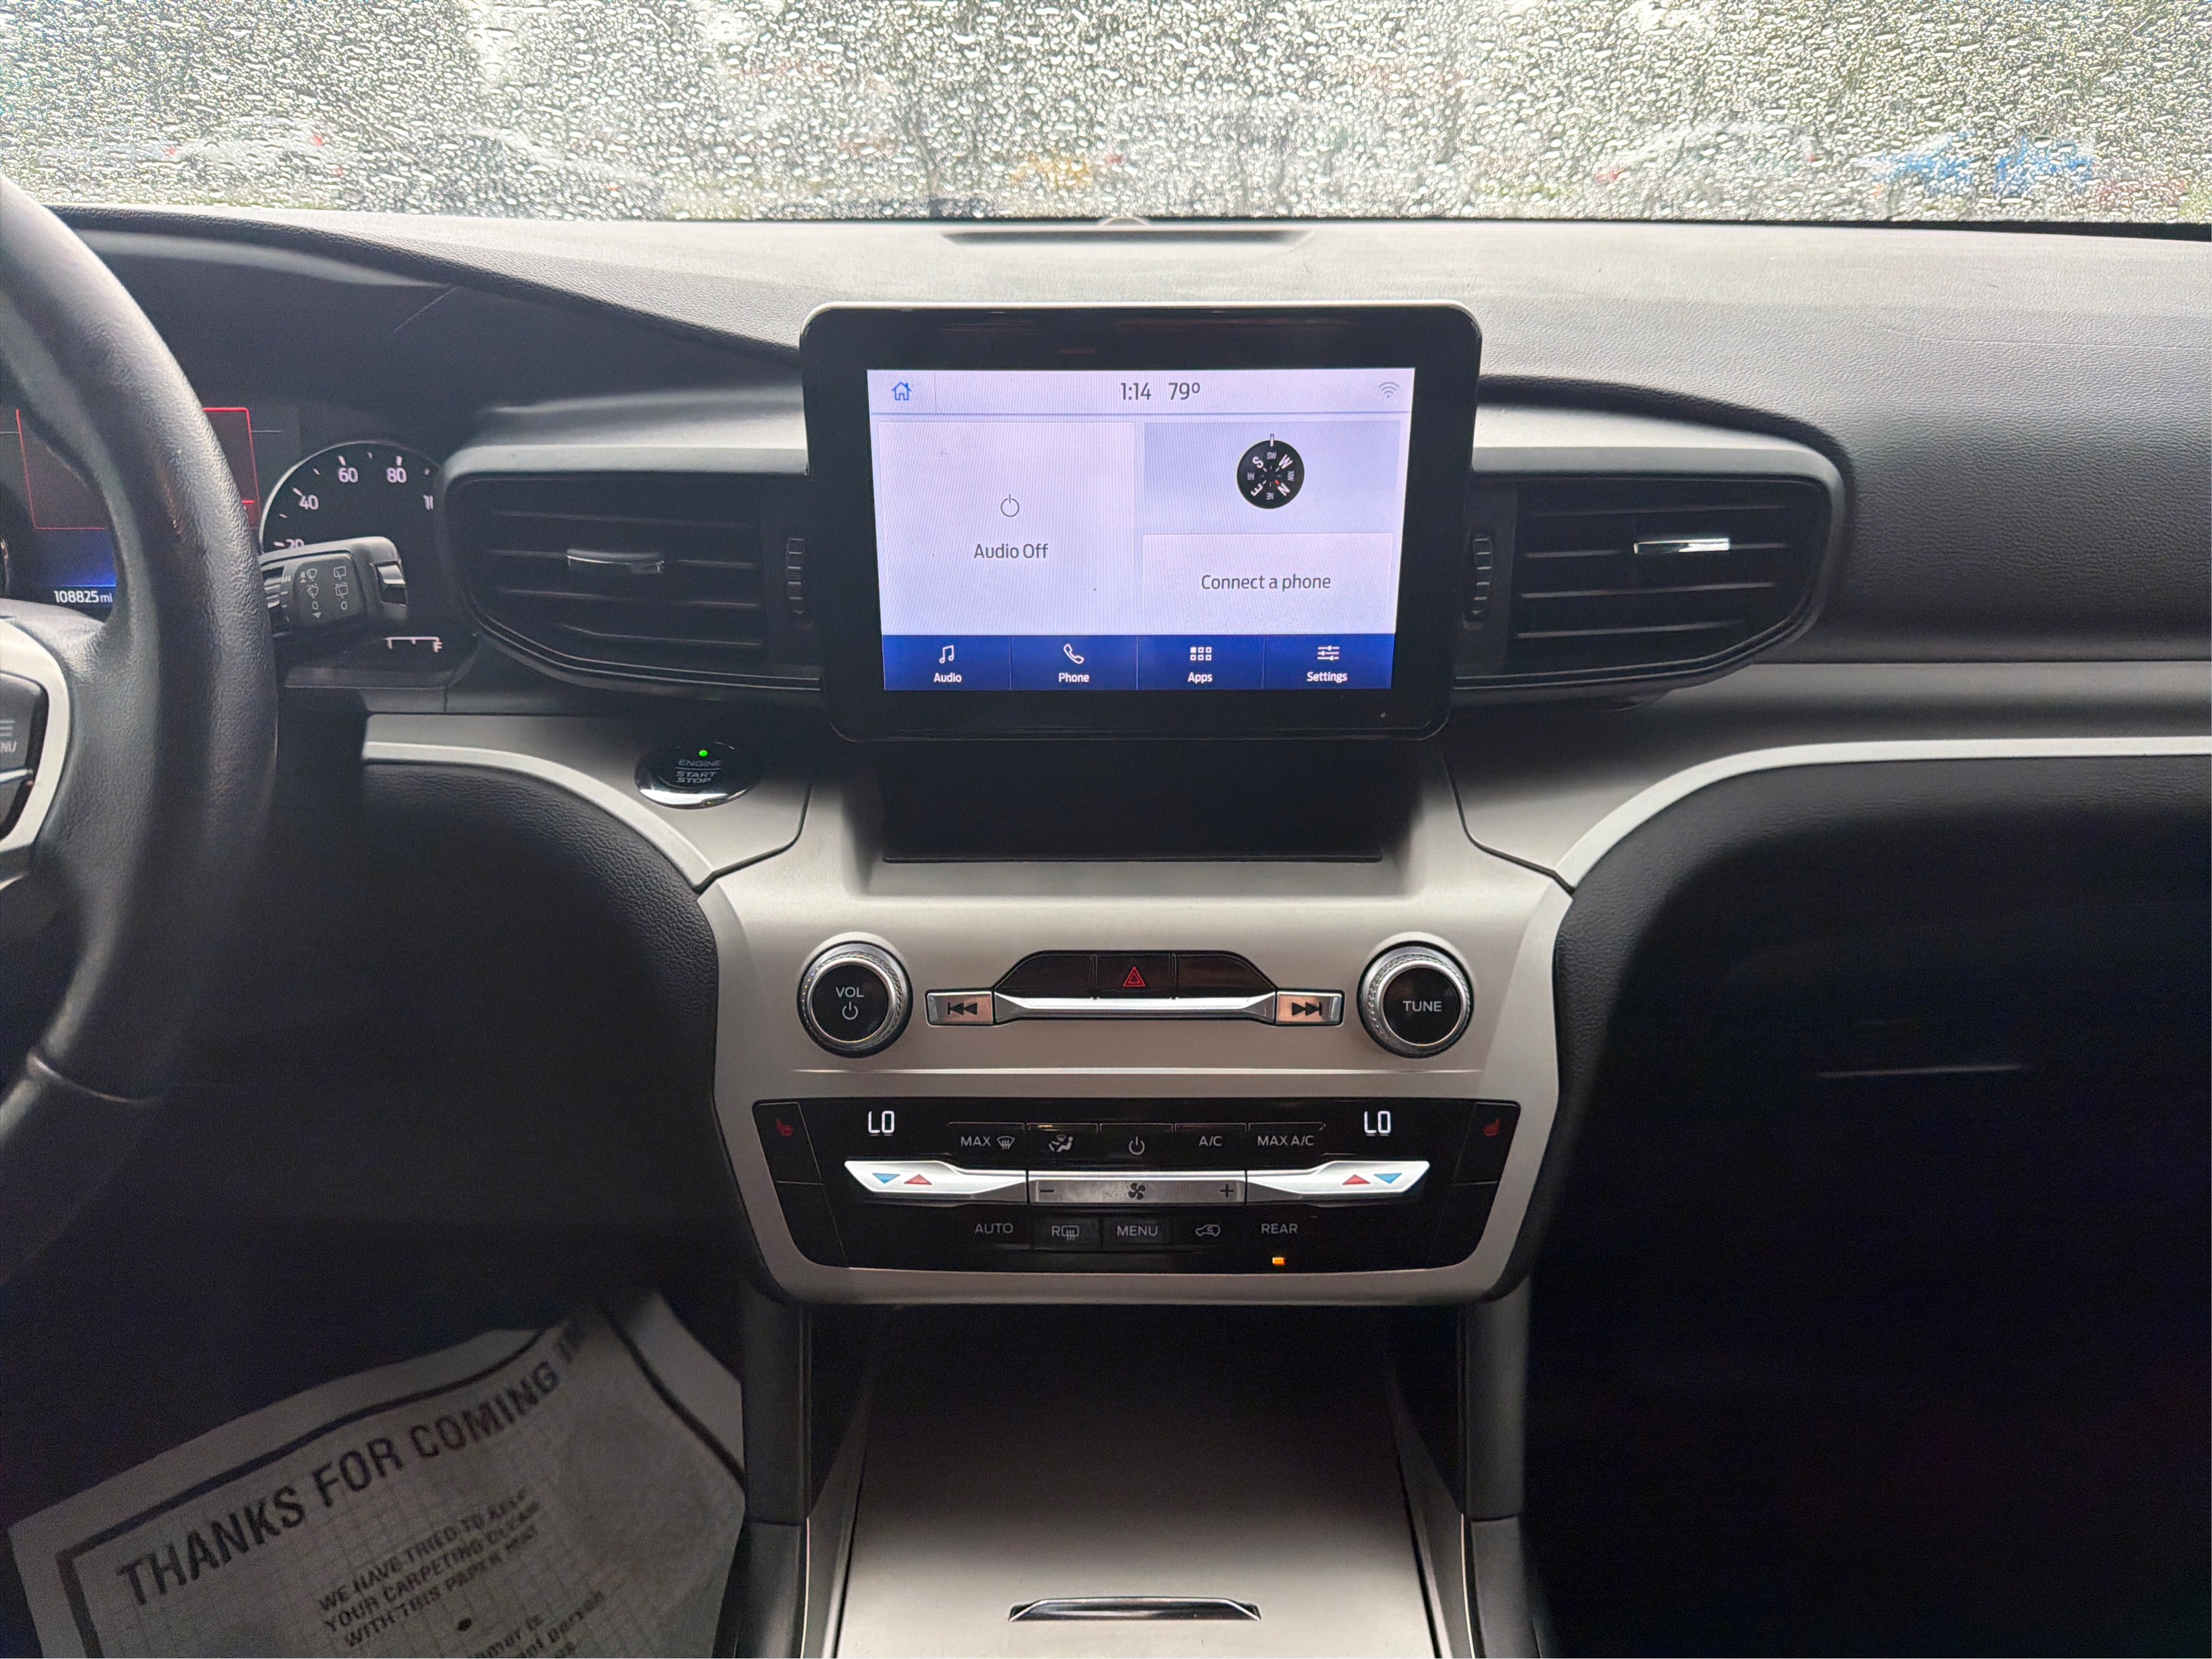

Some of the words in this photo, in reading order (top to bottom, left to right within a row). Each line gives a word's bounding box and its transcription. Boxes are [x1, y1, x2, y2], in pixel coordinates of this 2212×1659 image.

[1120, 382, 1152, 400] 1:14
[338, 467, 358, 483] 60
[386, 467, 408, 484] 80
[299, 494, 319, 511] 40
[974, 543, 1019, 560] Audio
[1023, 542, 1049, 560] Off
[1200, 573, 1266, 592] Connect
[1268, 578, 1278, 590] a
[1282, 573, 1332, 594] phone
[933, 672, 962, 684] Audio
[1058, 672, 1089, 684] Phone
[1187, 672, 1213, 686] Apps
[1306, 670, 1348, 686] Settings
[835, 987, 865, 997] VOL
[1403, 1001, 1443, 1012] TUNE
[960, 1136, 991, 1148] MAX
[1199, 1136, 1222, 1148] A/C
[1258, 1136, 1288, 1147] MAX
[1291, 1135, 1315, 1148] A/C
[975, 1223, 1014, 1235] AUTO
[1117, 1225, 1159, 1237] MENU
[1261, 1223, 1298, 1235] REAR
[116, 1483, 307, 1606] THANKS
[311, 1435, 404, 1508] FOR
[408, 1360, 561, 1459] COMING
[319, 1584, 348, 1612] WE
[352, 1554, 404, 1596] HAVE
[403, 1525, 459, 1567] TRIED
[460, 1512, 485, 1533] TO
[323, 1595, 380, 1633] YOUR
[382, 1538, 485, 1604] CARPETING
[343, 1610, 396, 1648] WITH
[394, 1585, 442, 1617] THIS
